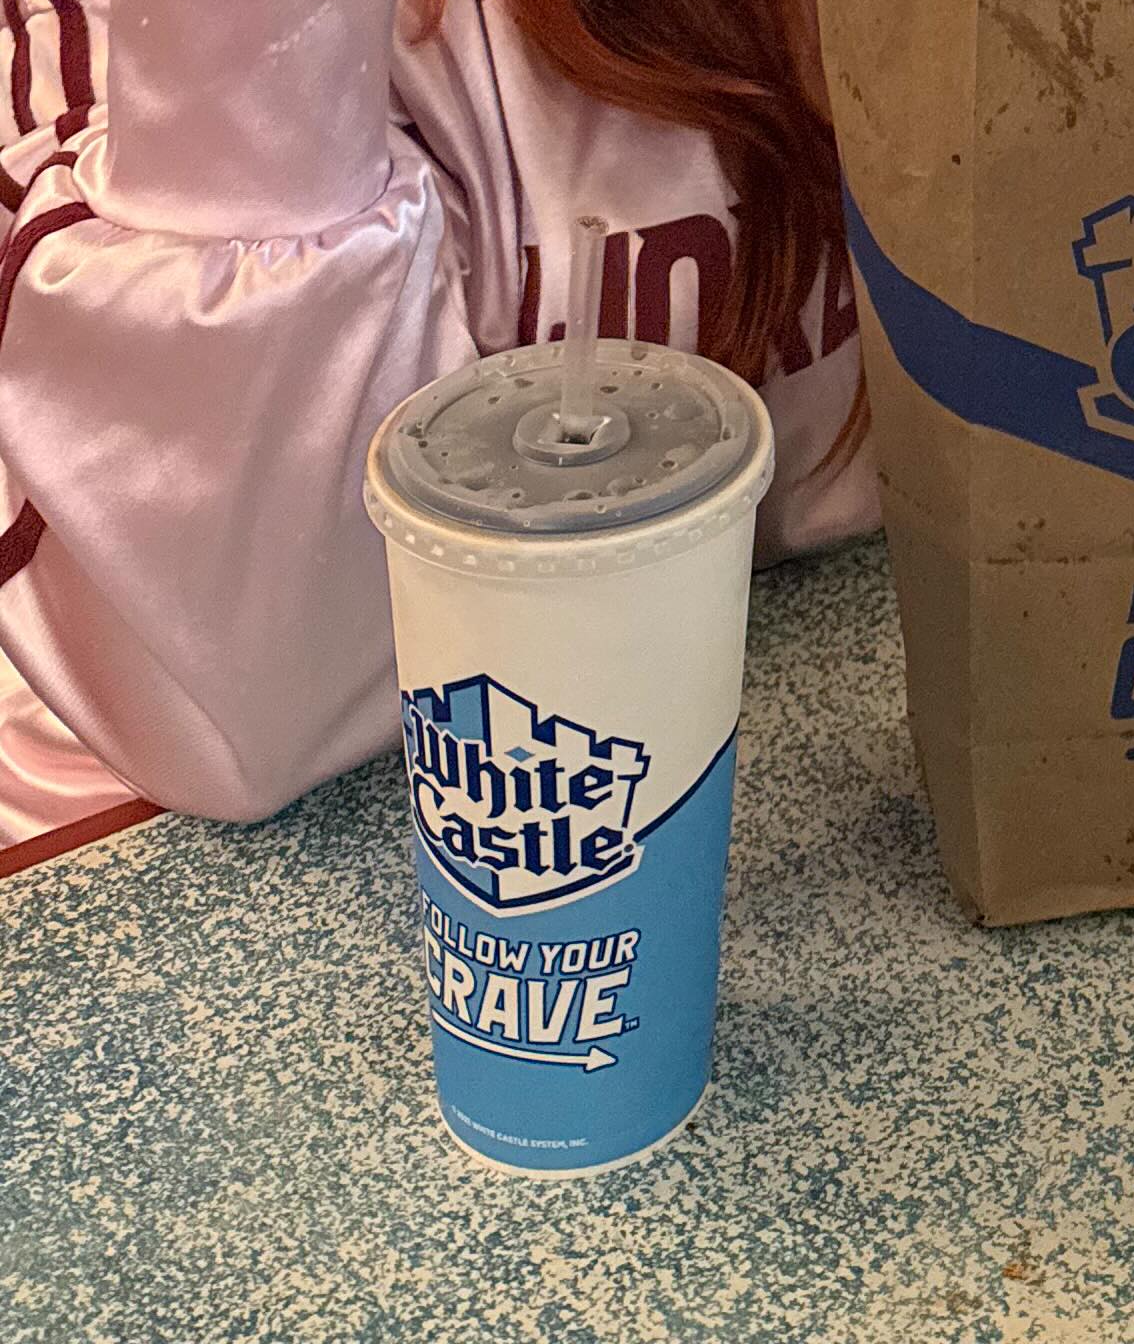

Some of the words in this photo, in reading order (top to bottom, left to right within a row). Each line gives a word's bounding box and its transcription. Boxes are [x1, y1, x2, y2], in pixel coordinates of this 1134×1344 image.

[412, 707, 614, 819] White
[412, 772, 624, 876] Castle
[421, 886, 532, 976] FOLLOW
[538, 927, 641, 976] YOUR
